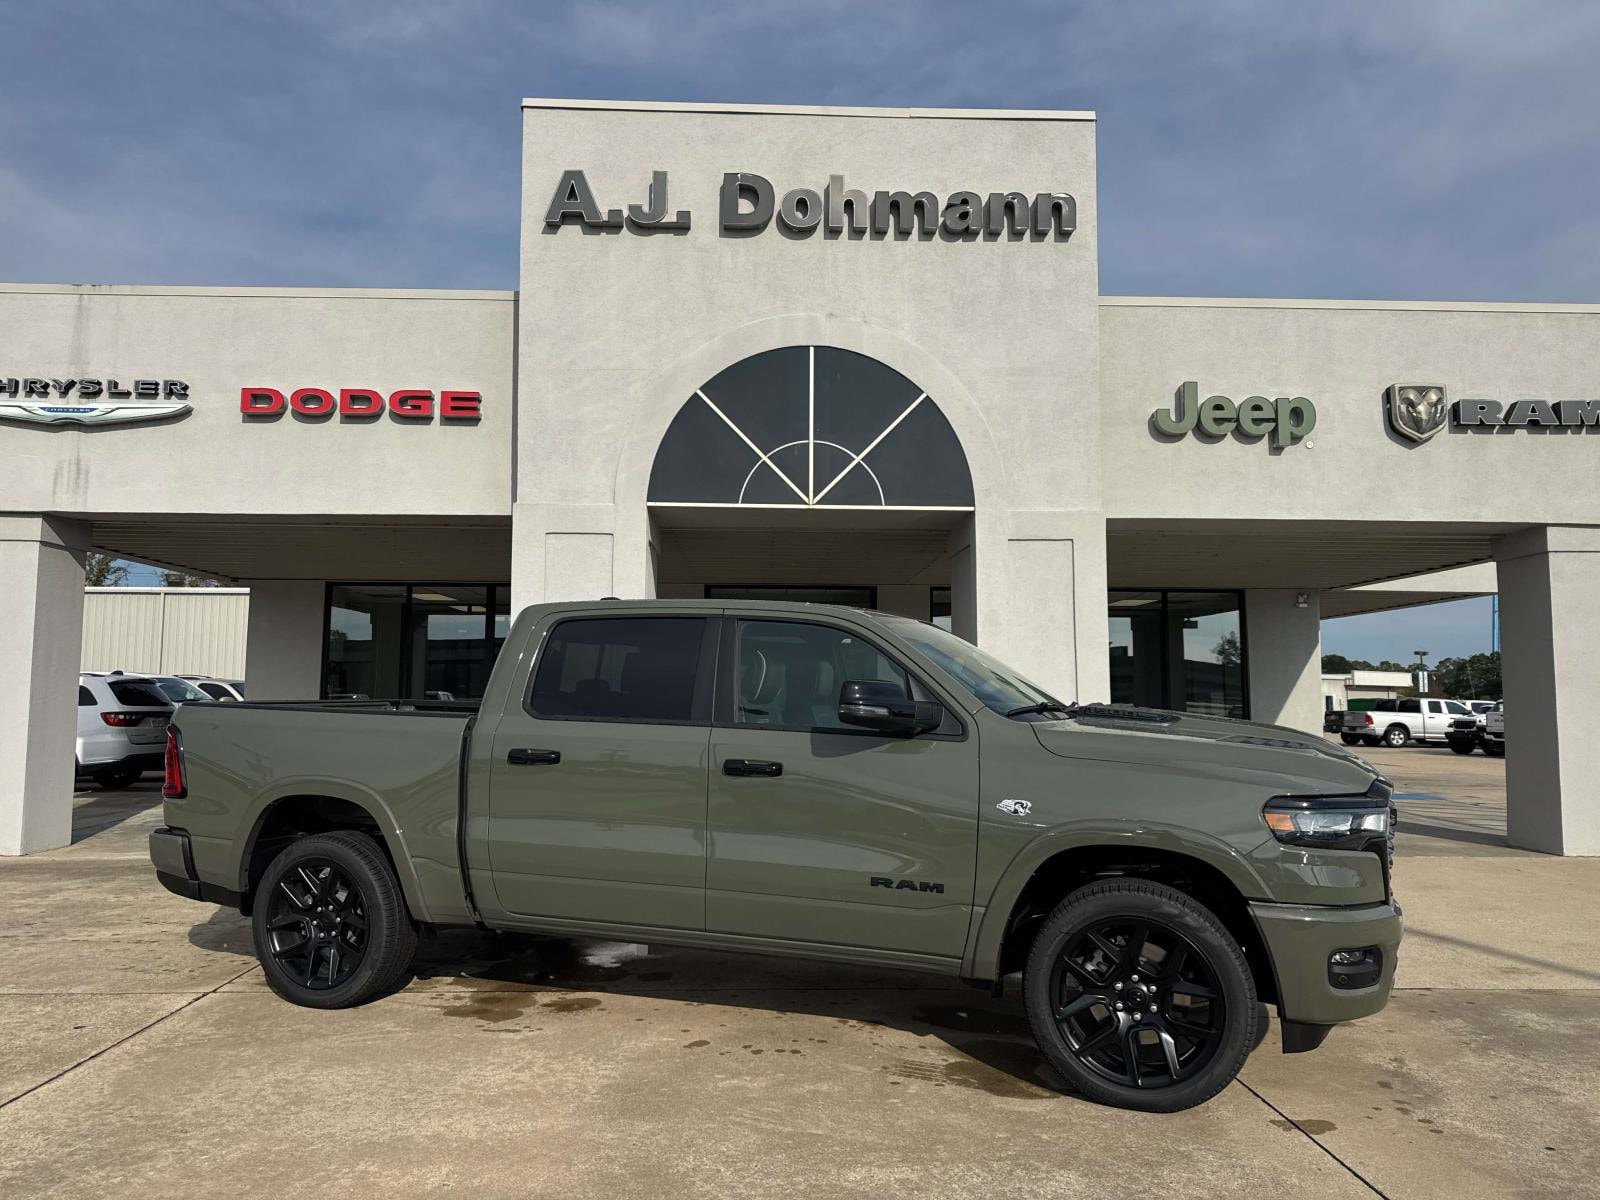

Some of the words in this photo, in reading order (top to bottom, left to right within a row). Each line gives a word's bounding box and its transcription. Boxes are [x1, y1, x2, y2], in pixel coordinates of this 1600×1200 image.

[543, 169, 691, 231] A.J.
[720, 172, 1077, 236] Dohmann
[241, 388, 481, 419] DODGE
[1154, 381, 1316, 448] Jeep
[1453, 400, 1600, 426] RAM
[870, 876, 944, 893] RAM
